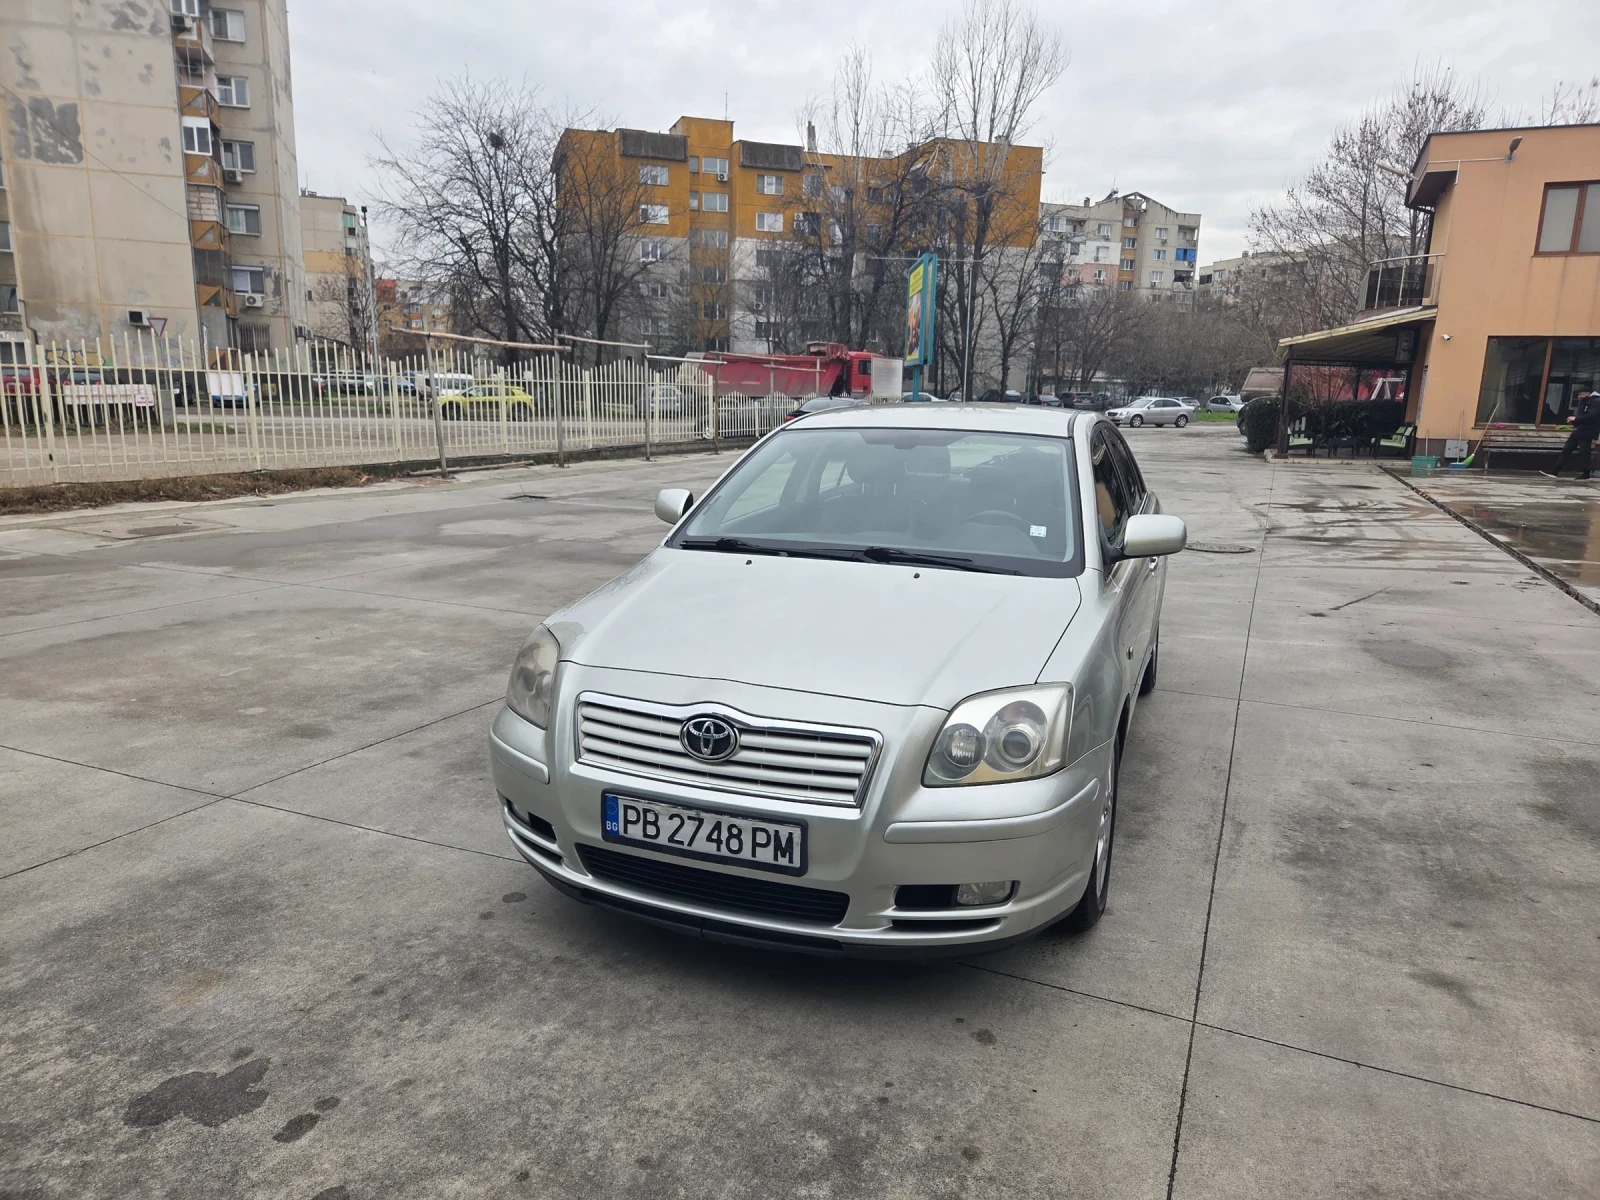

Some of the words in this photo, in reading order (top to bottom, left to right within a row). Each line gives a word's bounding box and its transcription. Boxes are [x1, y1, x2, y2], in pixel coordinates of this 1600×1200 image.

[605, 821, 618, 831] BG
[623, 804, 660, 839] PB
[667, 814, 743, 854] 2748
[751, 826, 793, 864] PM
